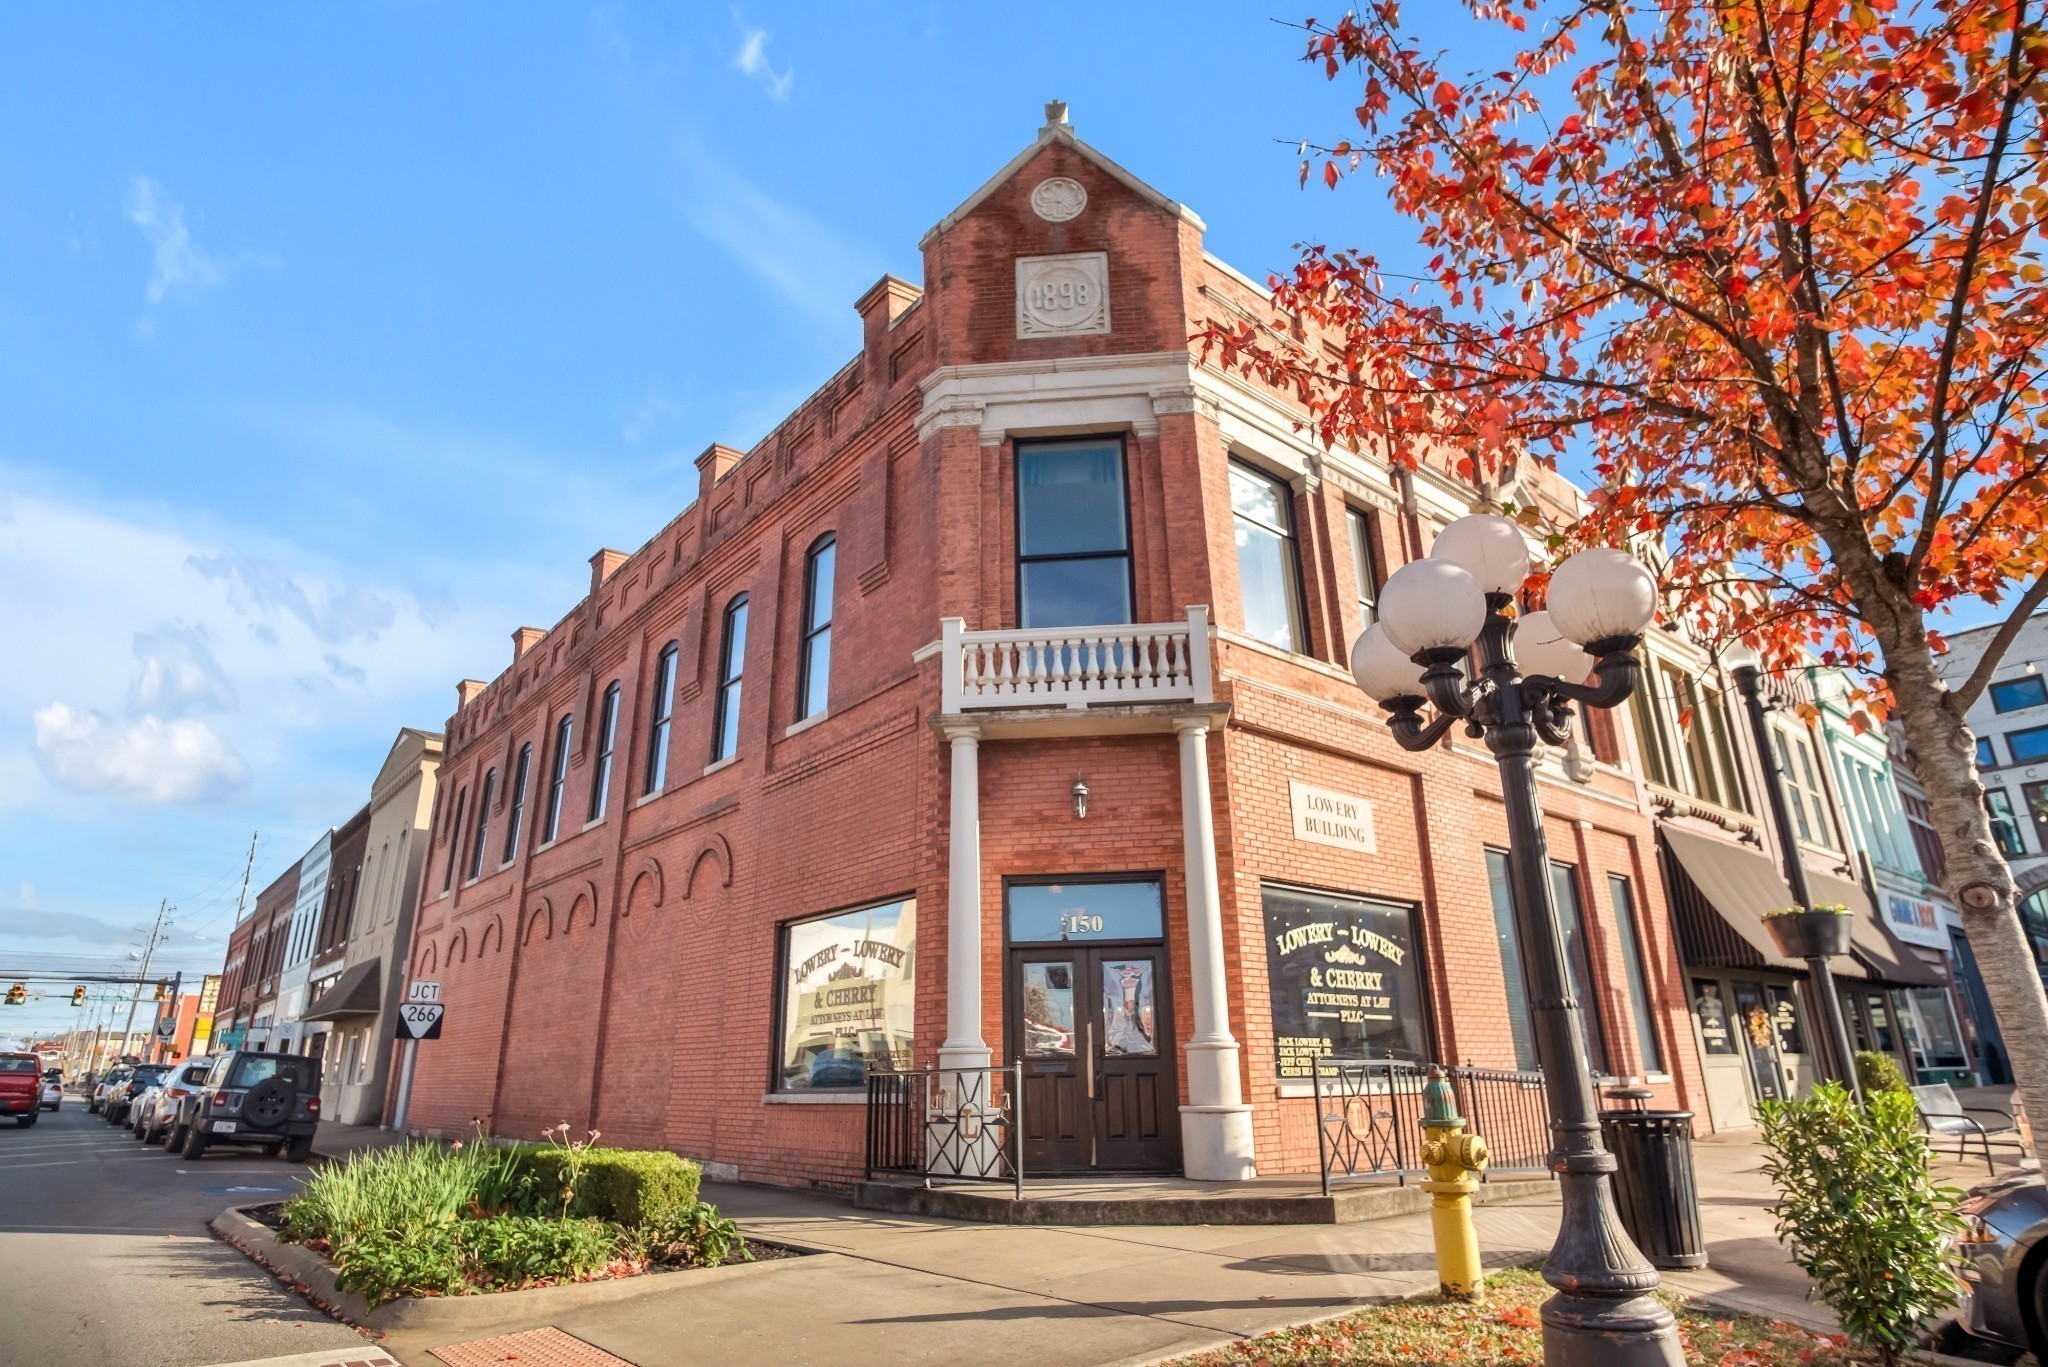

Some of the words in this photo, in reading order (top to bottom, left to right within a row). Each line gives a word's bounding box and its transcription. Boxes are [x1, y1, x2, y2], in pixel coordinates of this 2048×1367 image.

[1031, 281, 1090, 311] 1898
[1307, 794, 1358, 820] LOWERY
[1304, 816, 1365, 843] BUILDING
[1069, 914, 1103, 933] 150
[1276, 922, 1334, 956] LOWERY
[1351, 925, 1405, 966] LOWERY
[794, 943, 839, 985] LOWERY
[853, 939, 906, 969] LOWERY
[1310, 966, 1323, 988] &
[1325, 967, 1383, 991] CHERRY
[410, 984, 440, 999] JCT
[814, 991, 823, 1009] &
[826, 984, 878, 1008] CHERRY
[1306, 992, 1359, 1007] ATTORNEYS
[1360, 995, 1372, 1008] AT
[1373, 996, 1391, 1009] LAW
[407, 1006, 436, 1022] 266
[810, 1011, 852, 1025] ATTORNEYS
[853, 1009, 866, 1021] AT
[865, 1007, 885, 1020] LAW
[1340, 1010, 1365, 1023] PLLC
[835, 1026, 858, 1038] PLLC
